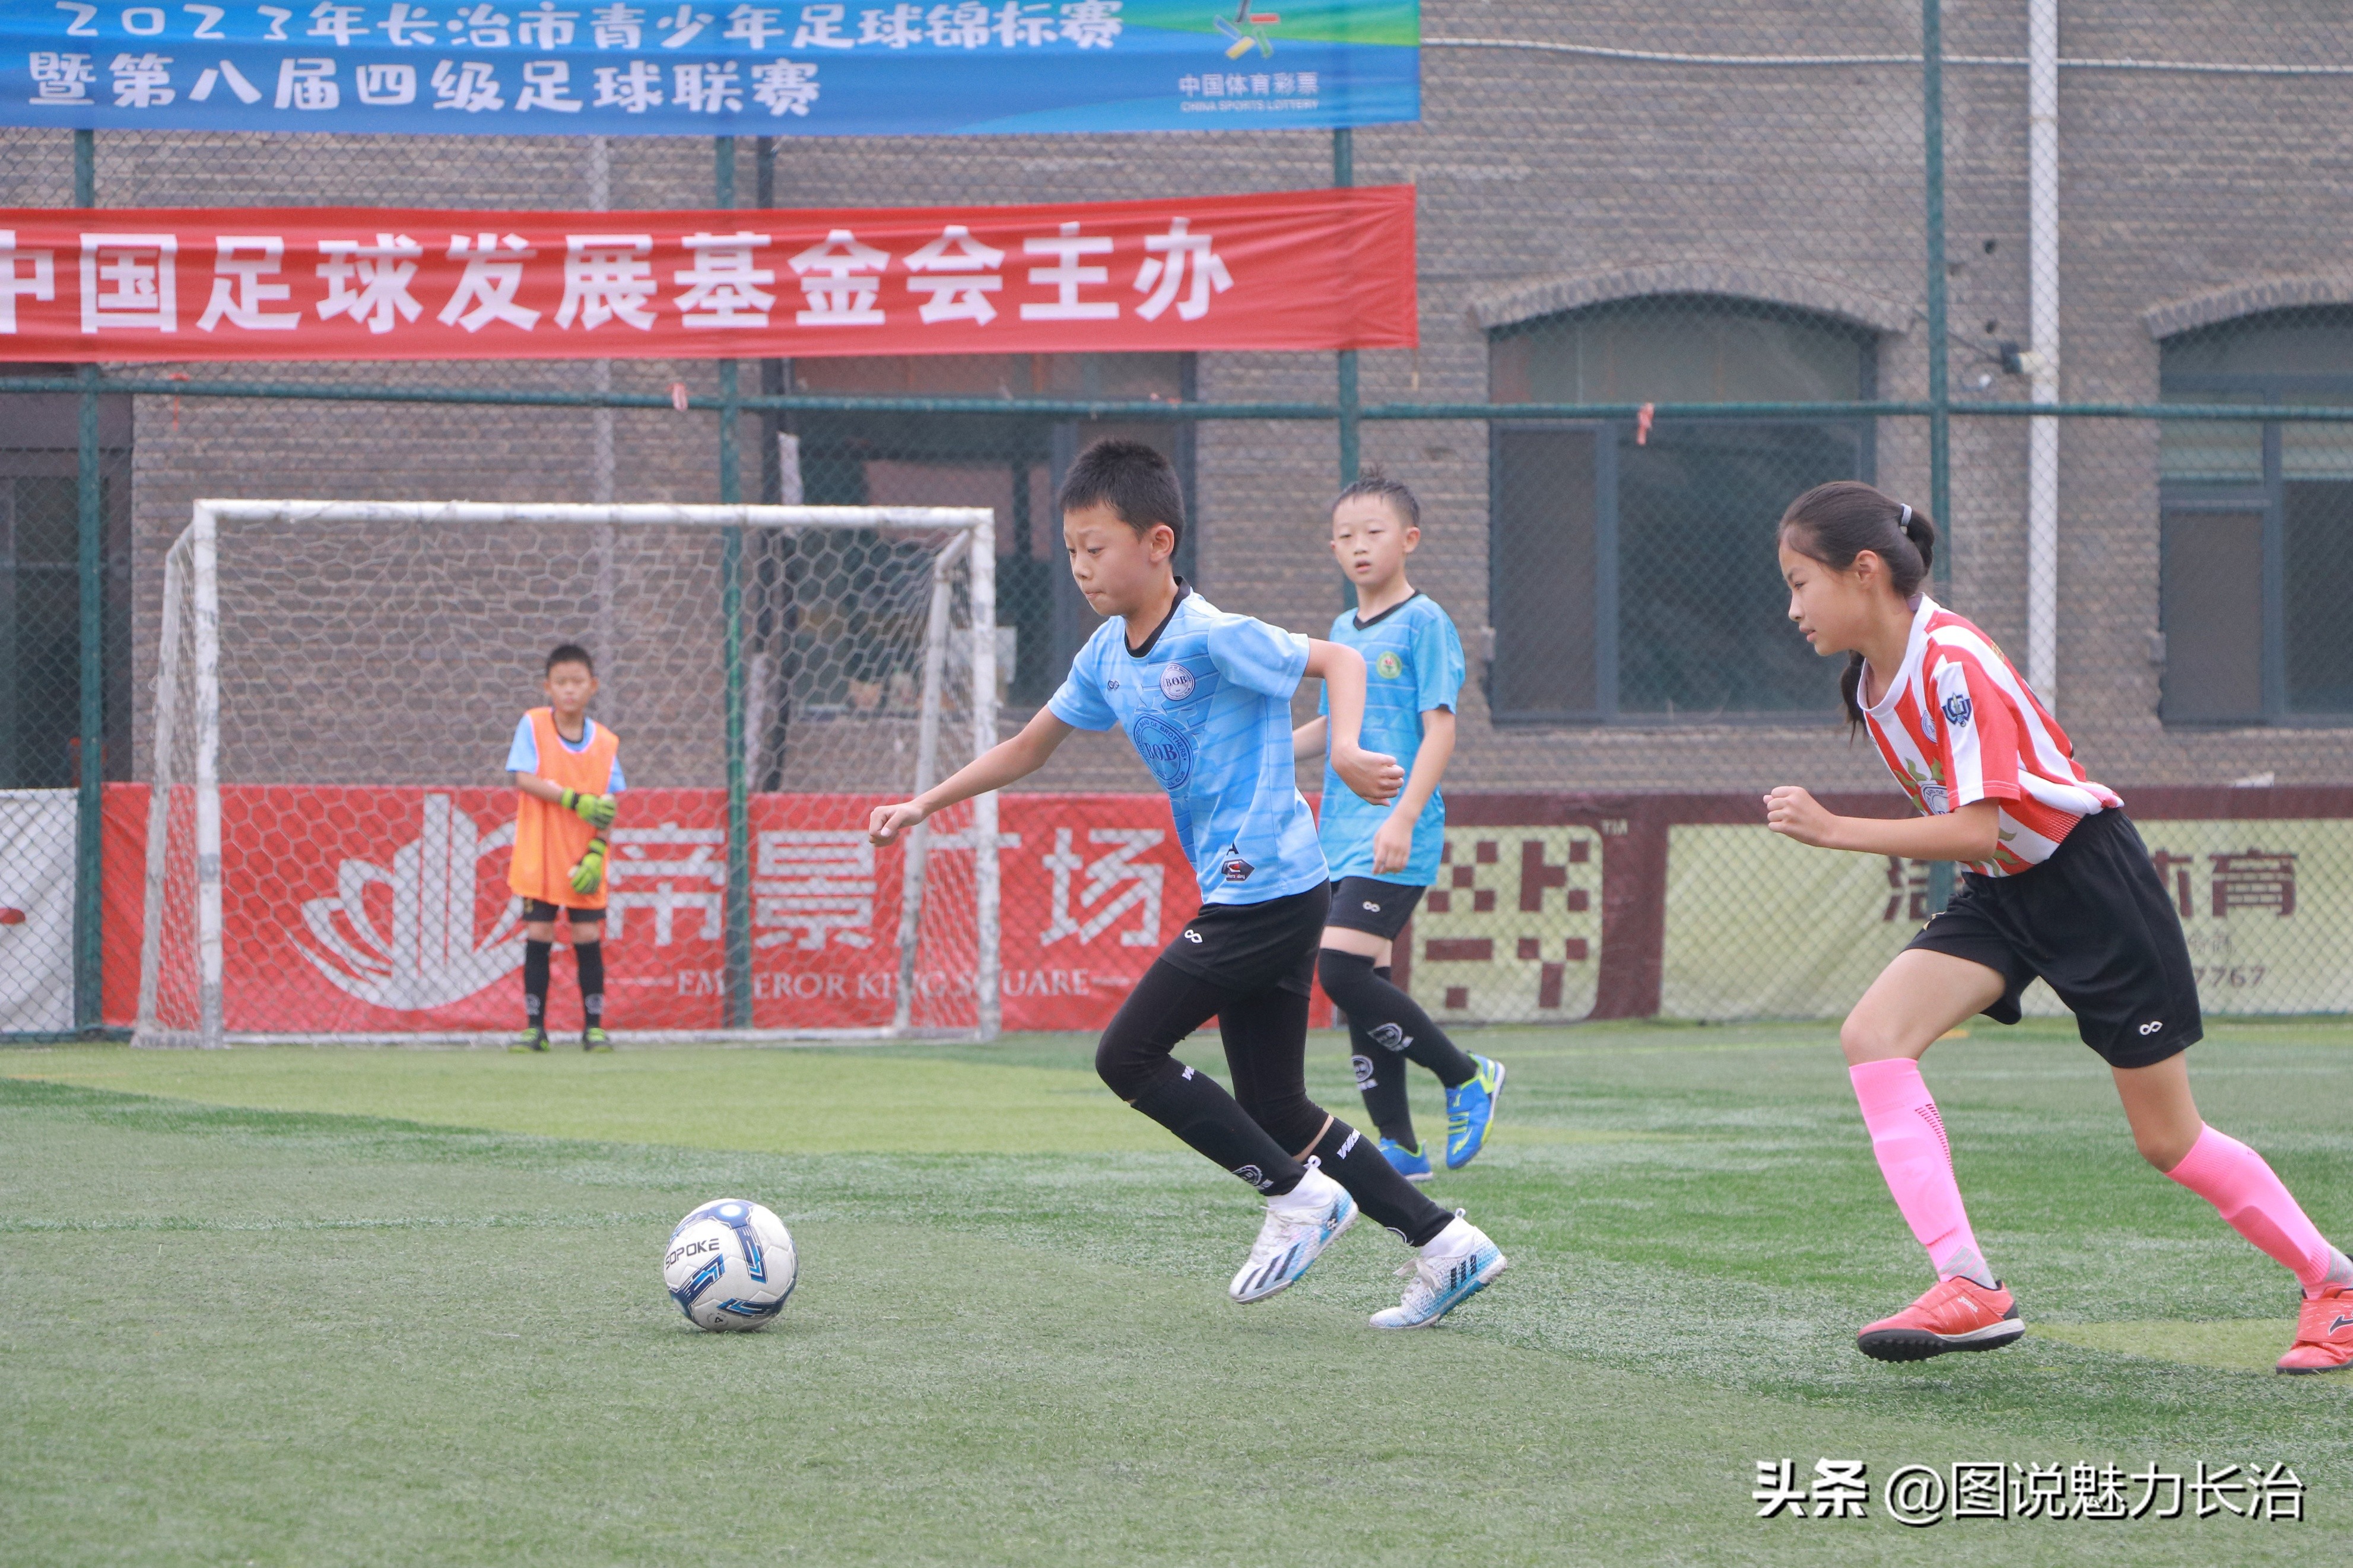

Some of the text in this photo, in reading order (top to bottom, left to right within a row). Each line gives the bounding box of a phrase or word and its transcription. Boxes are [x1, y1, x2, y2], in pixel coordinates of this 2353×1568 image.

[56, 1, 1123, 48] 2023年长治市青少年足球锦标赛
[28, 51, 820, 116] 暨第八届四级足球联赛
[1179, 72, 1319, 97] 中国体育彩票
[0, 216, 1233, 334] 中国足球发展基金会主办
[1159, 726, 1187, 758] BROTHERS
[678, 968, 1090, 1000] EMEROR KIG SUARE
